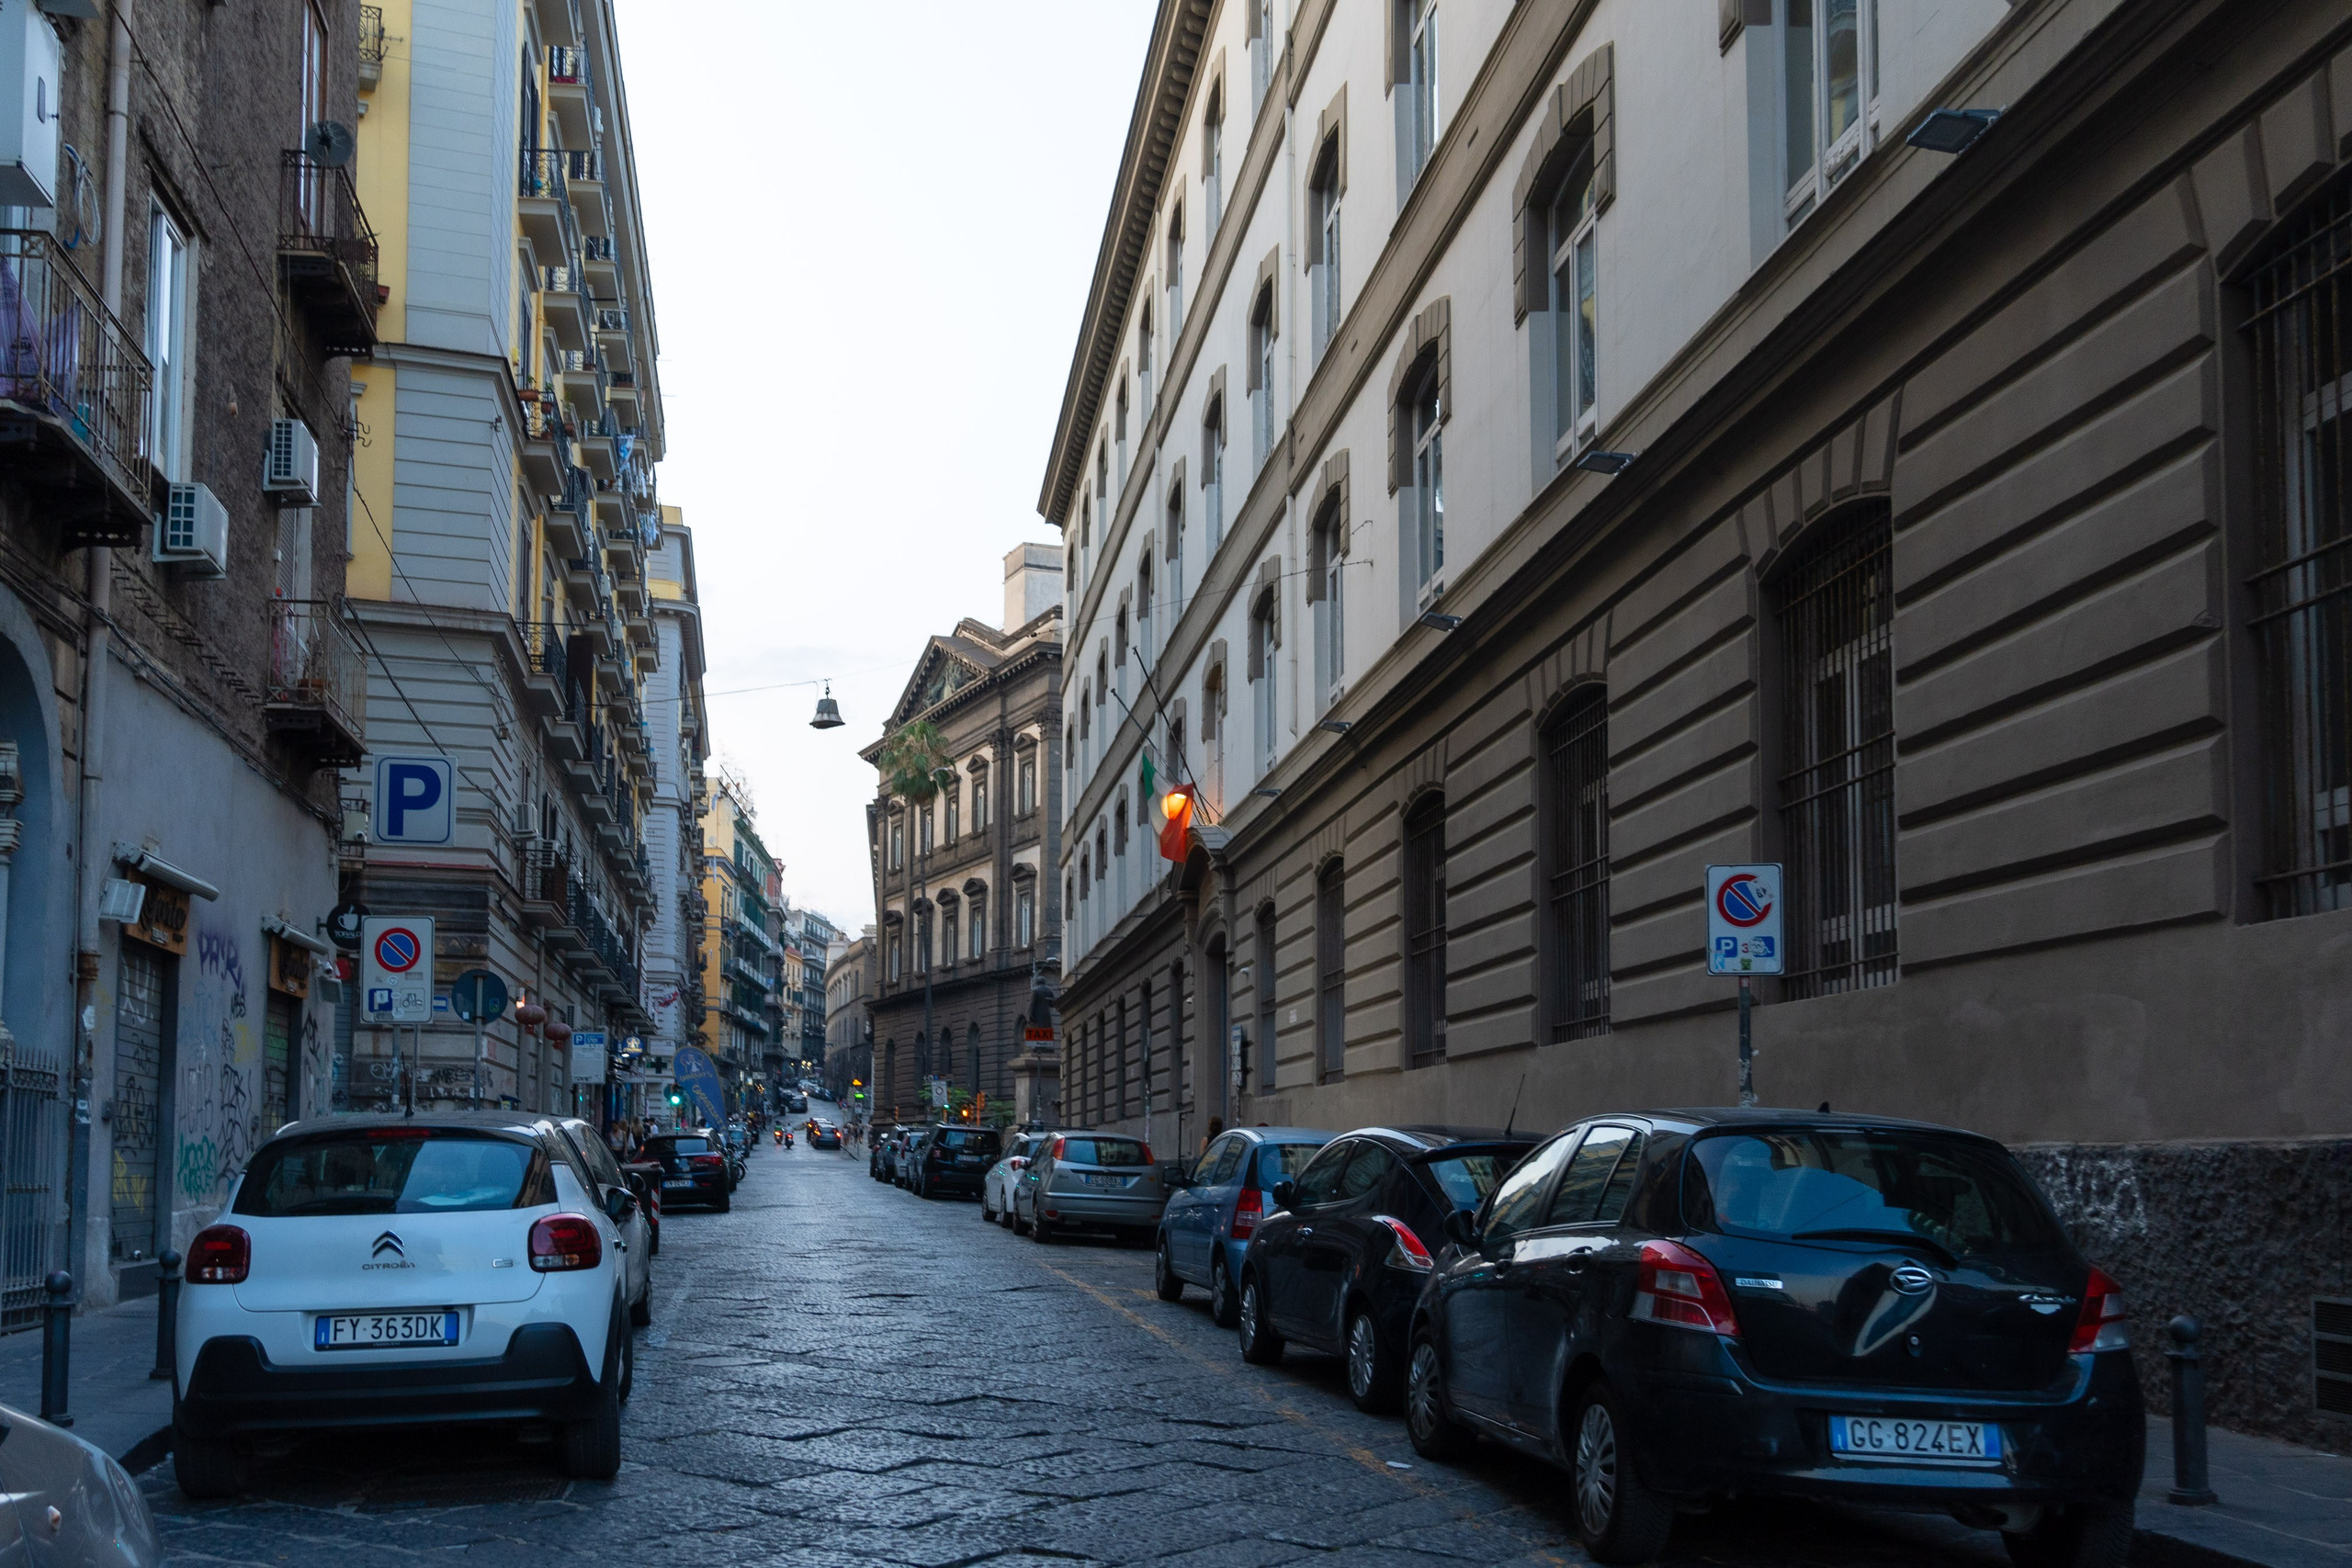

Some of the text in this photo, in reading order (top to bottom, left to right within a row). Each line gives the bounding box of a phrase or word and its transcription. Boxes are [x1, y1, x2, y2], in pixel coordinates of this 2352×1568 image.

[387, 763, 441, 837] P
[1721, 940, 1734, 955] P
[575, 1034, 583, 1044] P
[1026, 1030, 1053, 1040] TAXI
[492, 1258, 514, 1269] C3
[333, 1317, 360, 1341] FY
[370, 1315, 444, 1339] 363DK
[1850, 1419, 1883, 1449] GG
[1894, 1422, 1982, 1455] 824EX
